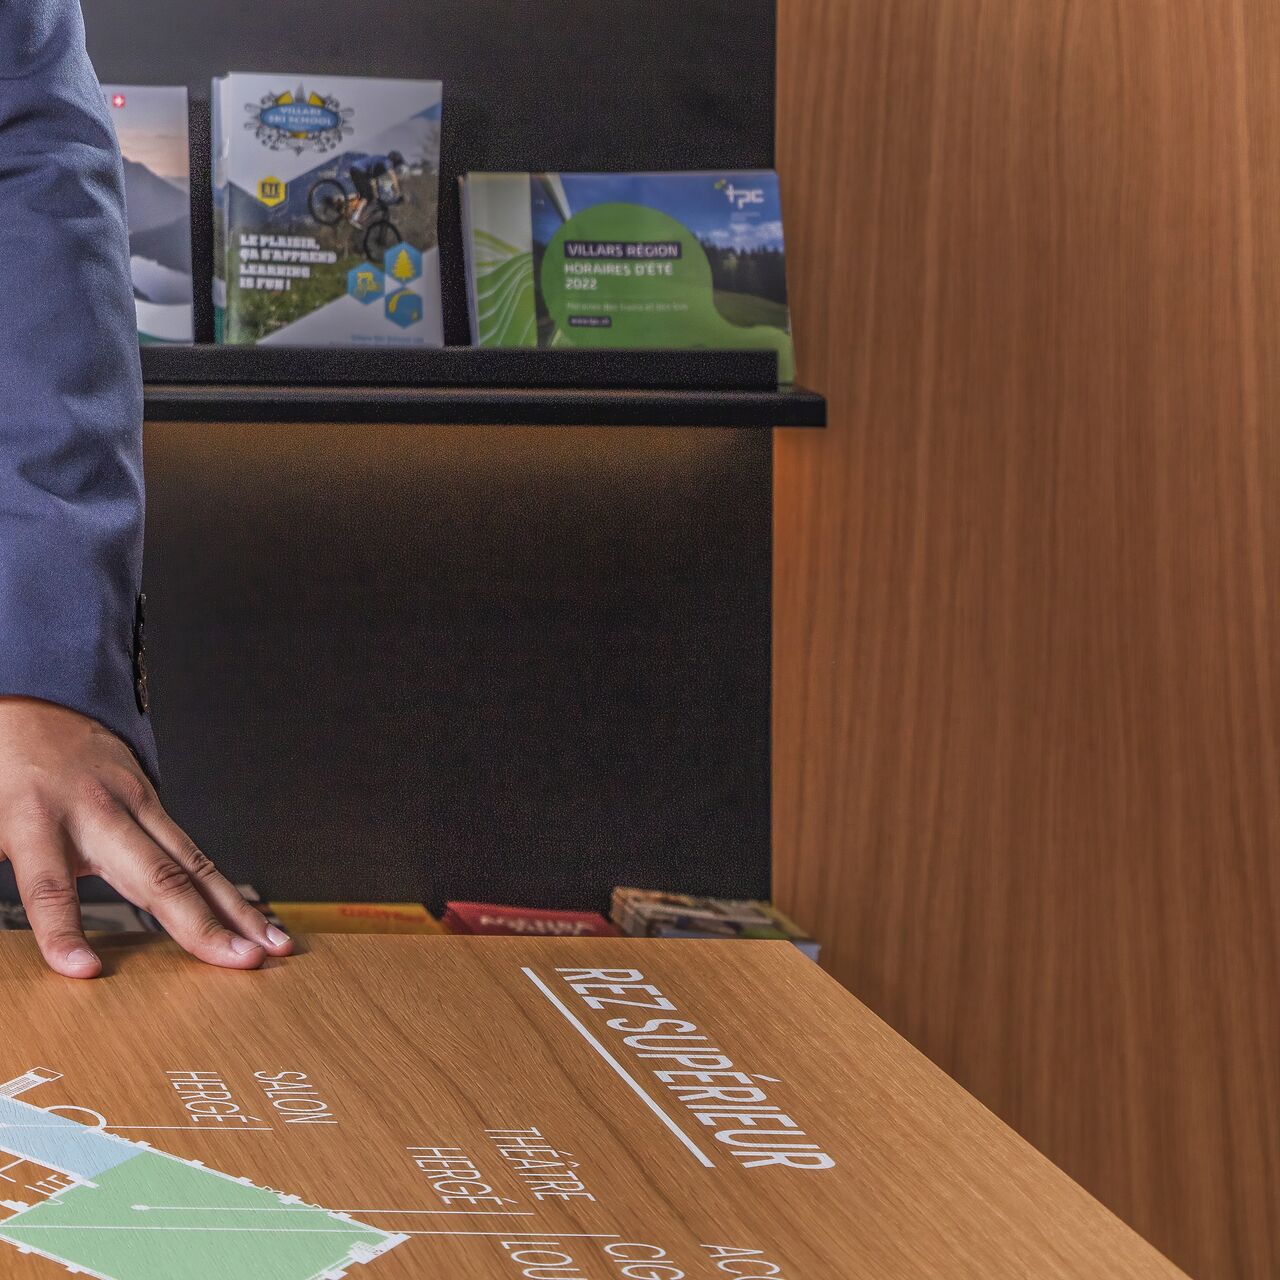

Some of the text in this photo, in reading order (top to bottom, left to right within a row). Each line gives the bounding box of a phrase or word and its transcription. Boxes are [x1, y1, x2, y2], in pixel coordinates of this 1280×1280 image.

[268, 115, 332, 126] SKI SCHOOL
[724, 184, 766, 210] tpc
[240, 234, 258, 246] LE
[566, 241, 679, 258] VILLARS RÉGION
[239, 263, 311, 278] LEARNING
[563, 261, 674, 276] HORAIRES D'ÉTÉ
[239, 277, 255, 289] IS
[256, 278, 285, 290] FUN
[564, 277, 598, 291] 2022
[553, 967, 836, 1170] REZ SUPÉRIEUR
[165, 1070, 264, 1123] HERGÉ
[253, 1069, 339, 1125] SALON
[484, 1126, 597, 1203] THÉÂTRE
[405, 1146, 519, 1205] HERGÉ
[699, 1244, 785, 1280] AC
